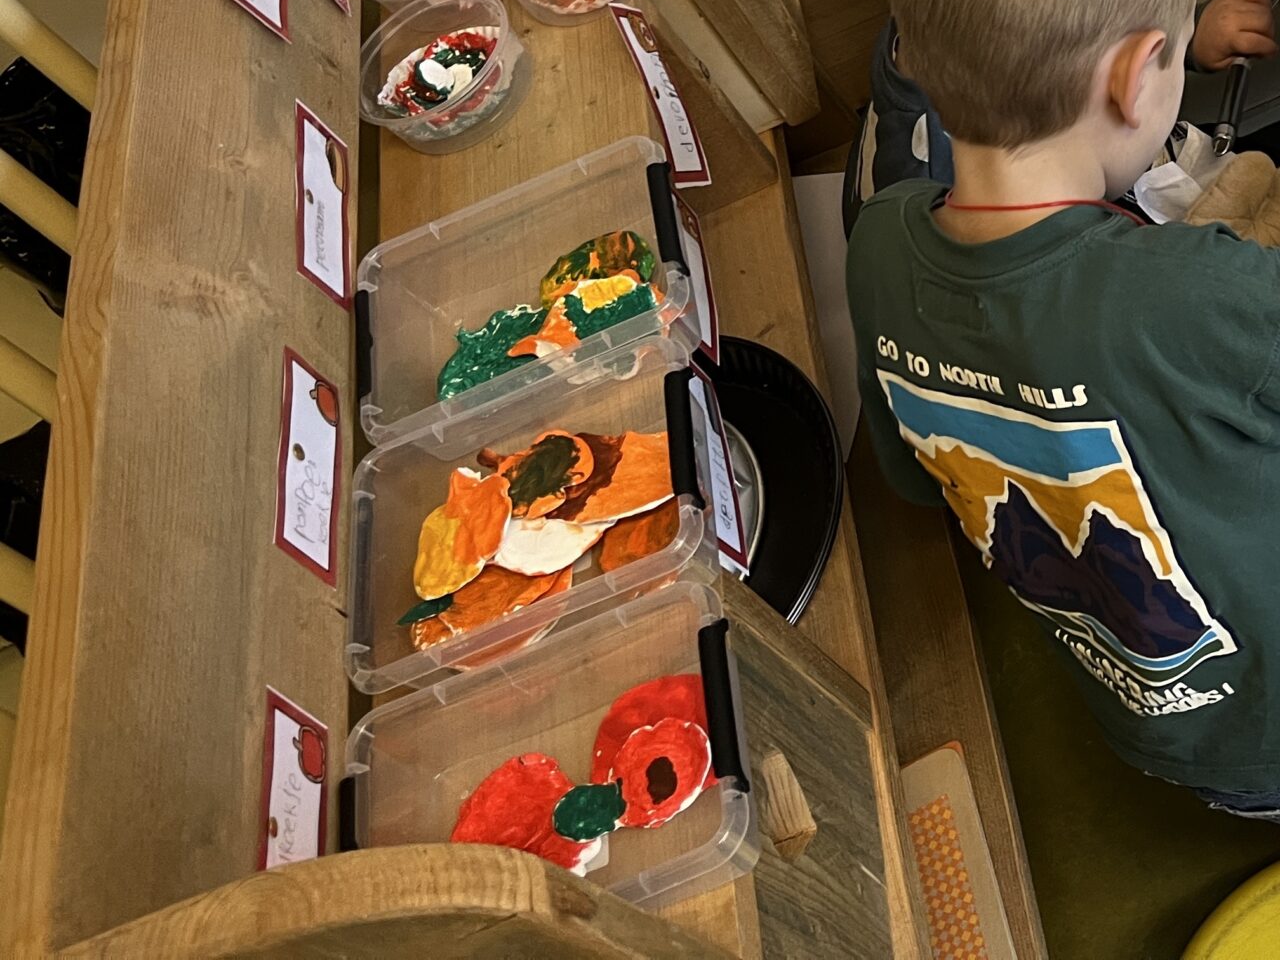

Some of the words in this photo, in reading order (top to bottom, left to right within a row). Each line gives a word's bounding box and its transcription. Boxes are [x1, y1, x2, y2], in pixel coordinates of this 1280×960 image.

[877, 335, 899, 362] GO
[905, 350, 930, 377] TO
[939, 361, 1005, 396] NORTH
[1018, 384, 1089, 410] HILLS
